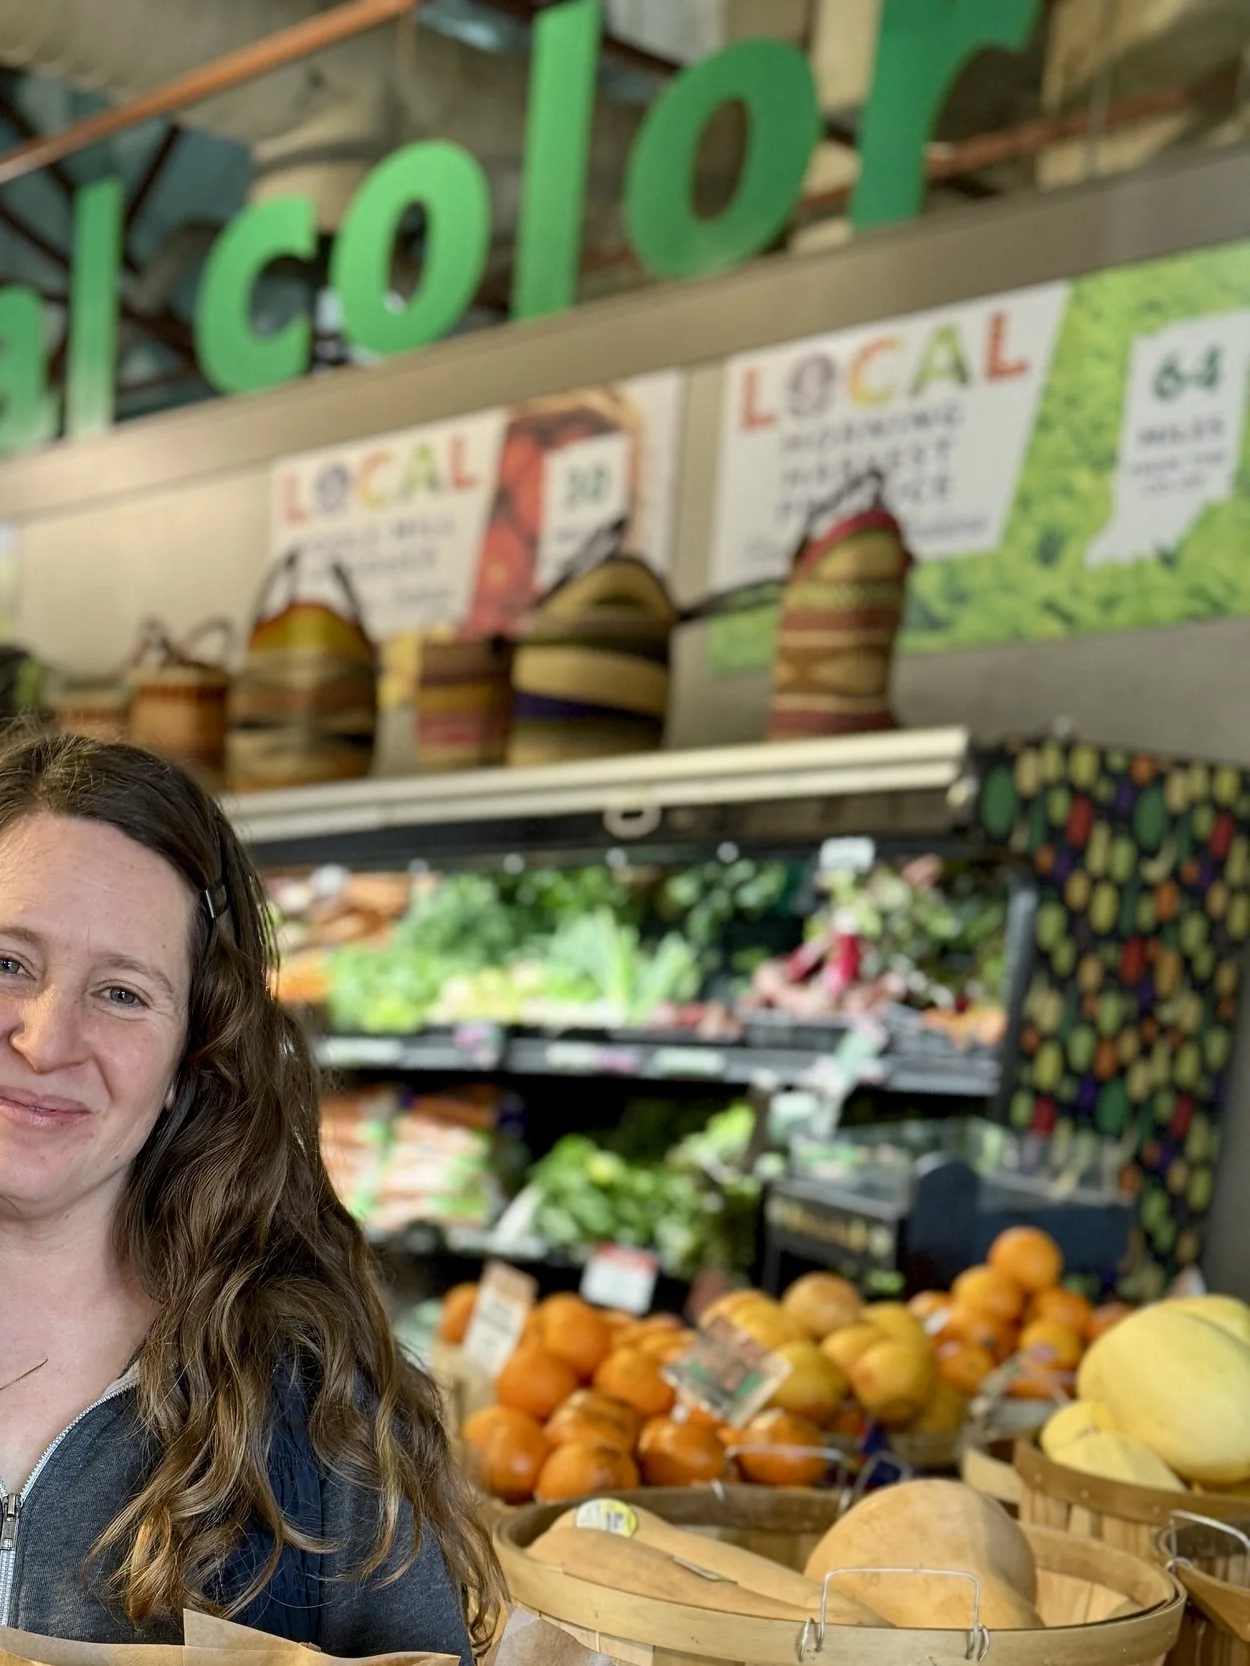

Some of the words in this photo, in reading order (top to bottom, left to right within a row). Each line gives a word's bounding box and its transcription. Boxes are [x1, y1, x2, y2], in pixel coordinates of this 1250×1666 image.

[197, 0, 1041, 394] color
[739, 311, 1031, 432] LOCAL
[282, 432, 478, 525] LOCAL
